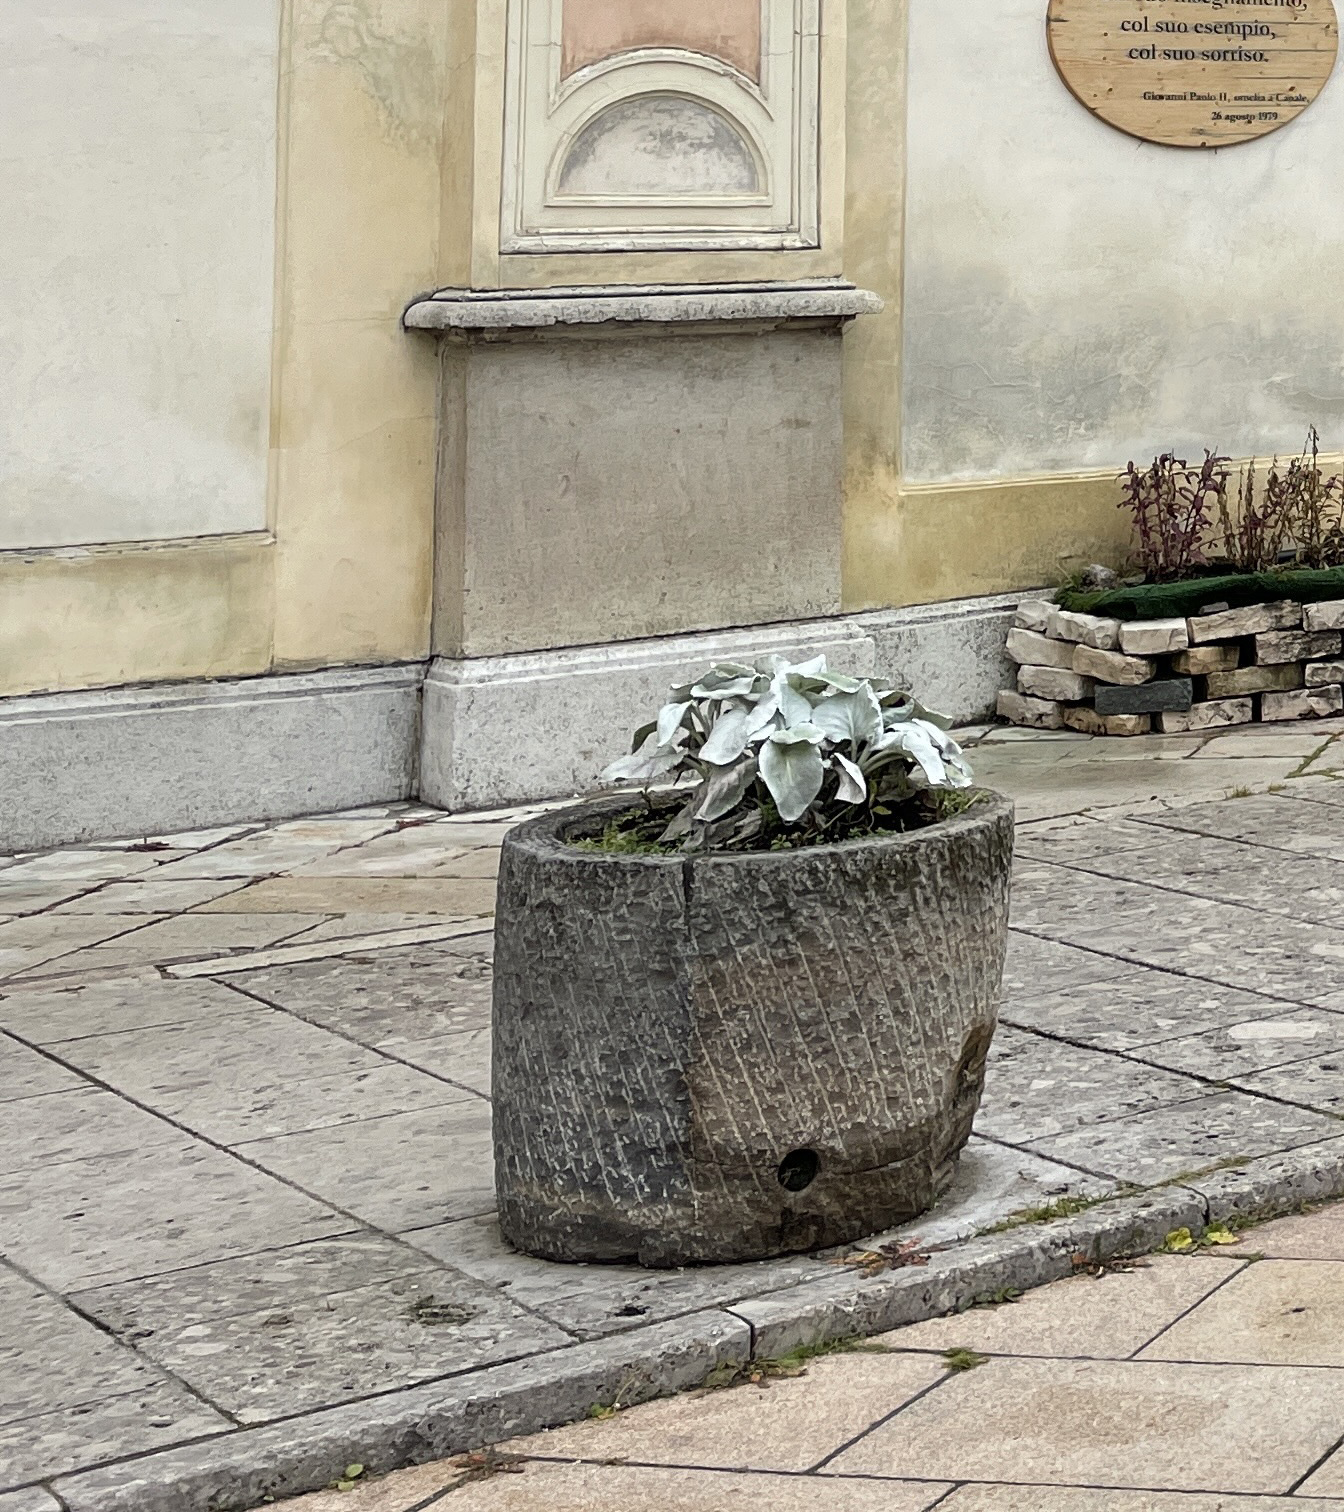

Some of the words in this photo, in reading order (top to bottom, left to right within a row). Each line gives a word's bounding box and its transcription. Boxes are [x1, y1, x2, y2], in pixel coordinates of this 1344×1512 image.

[1121, 16, 1149, 33] col
[1155, 21, 1188, 34] suo
[1194, 19, 1276, 40] esempio,
[1128, 44, 1156, 60] col
[1162, 49, 1195, 61] suo
[1201, 45, 1269, 62] sorriso.
[1143, 91, 1187, 101] Giovanni
[1189, 91, 1216, 101] Paolo
[1211, 111, 1222, 121] 26
[1224, 112, 1256, 123] agosto
